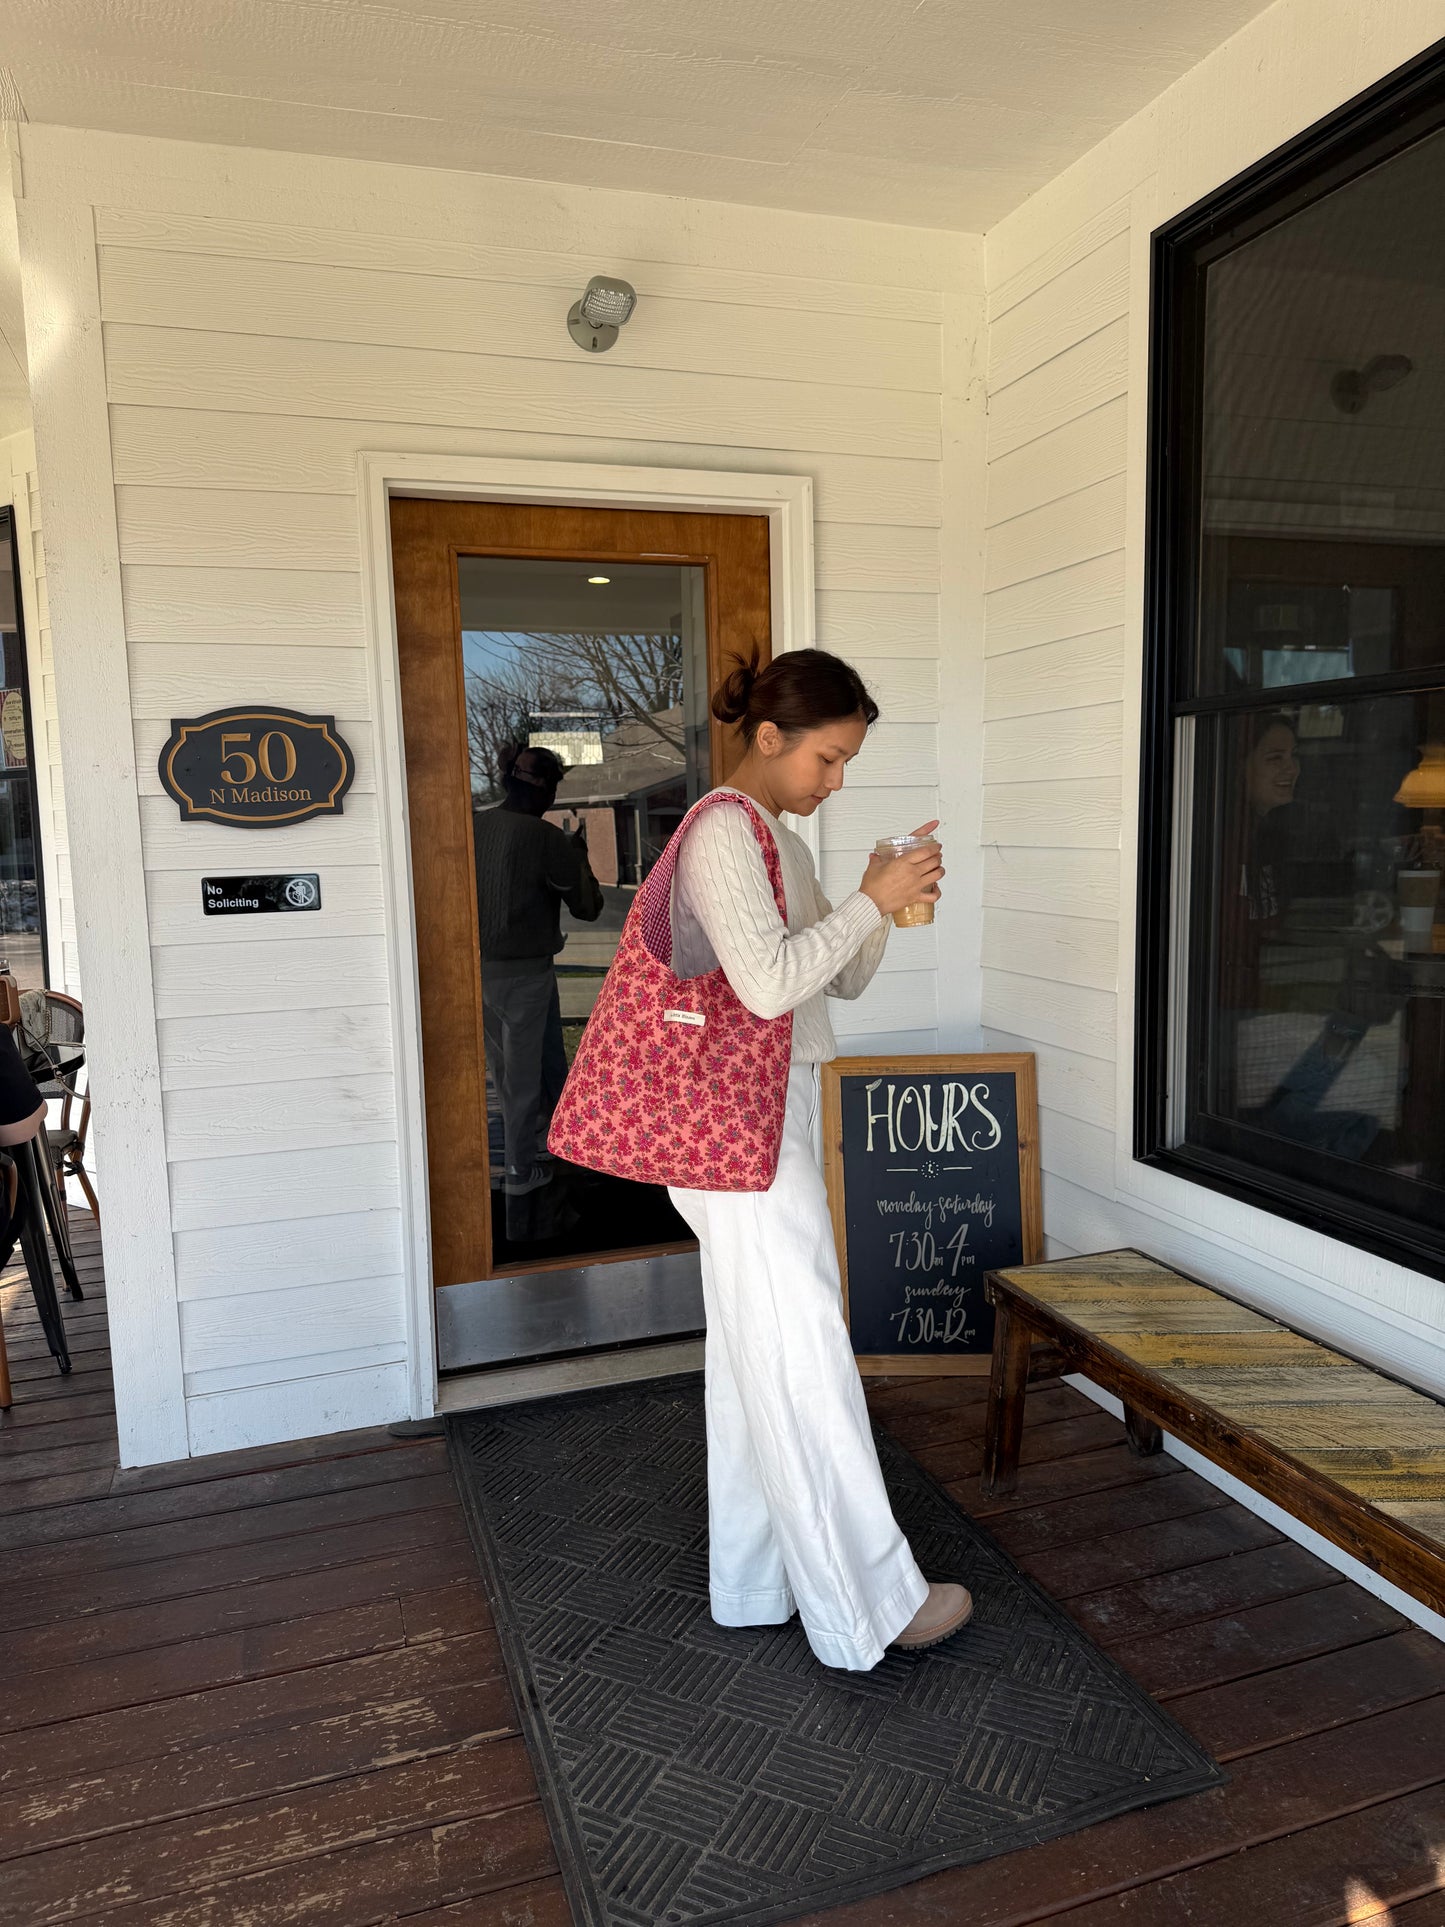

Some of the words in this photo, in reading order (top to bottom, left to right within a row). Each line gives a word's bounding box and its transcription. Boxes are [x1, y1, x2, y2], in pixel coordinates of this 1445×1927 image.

[220, 731, 297, 785] 50
[209, 788, 226, 804] N
[231, 787, 312, 804] Madison
[207, 885, 223, 895] No
[208, 898, 259, 909] Soliciting
[865, 1078, 1002, 1152] HOURS
[904, 1279, 971, 1308] sunday
